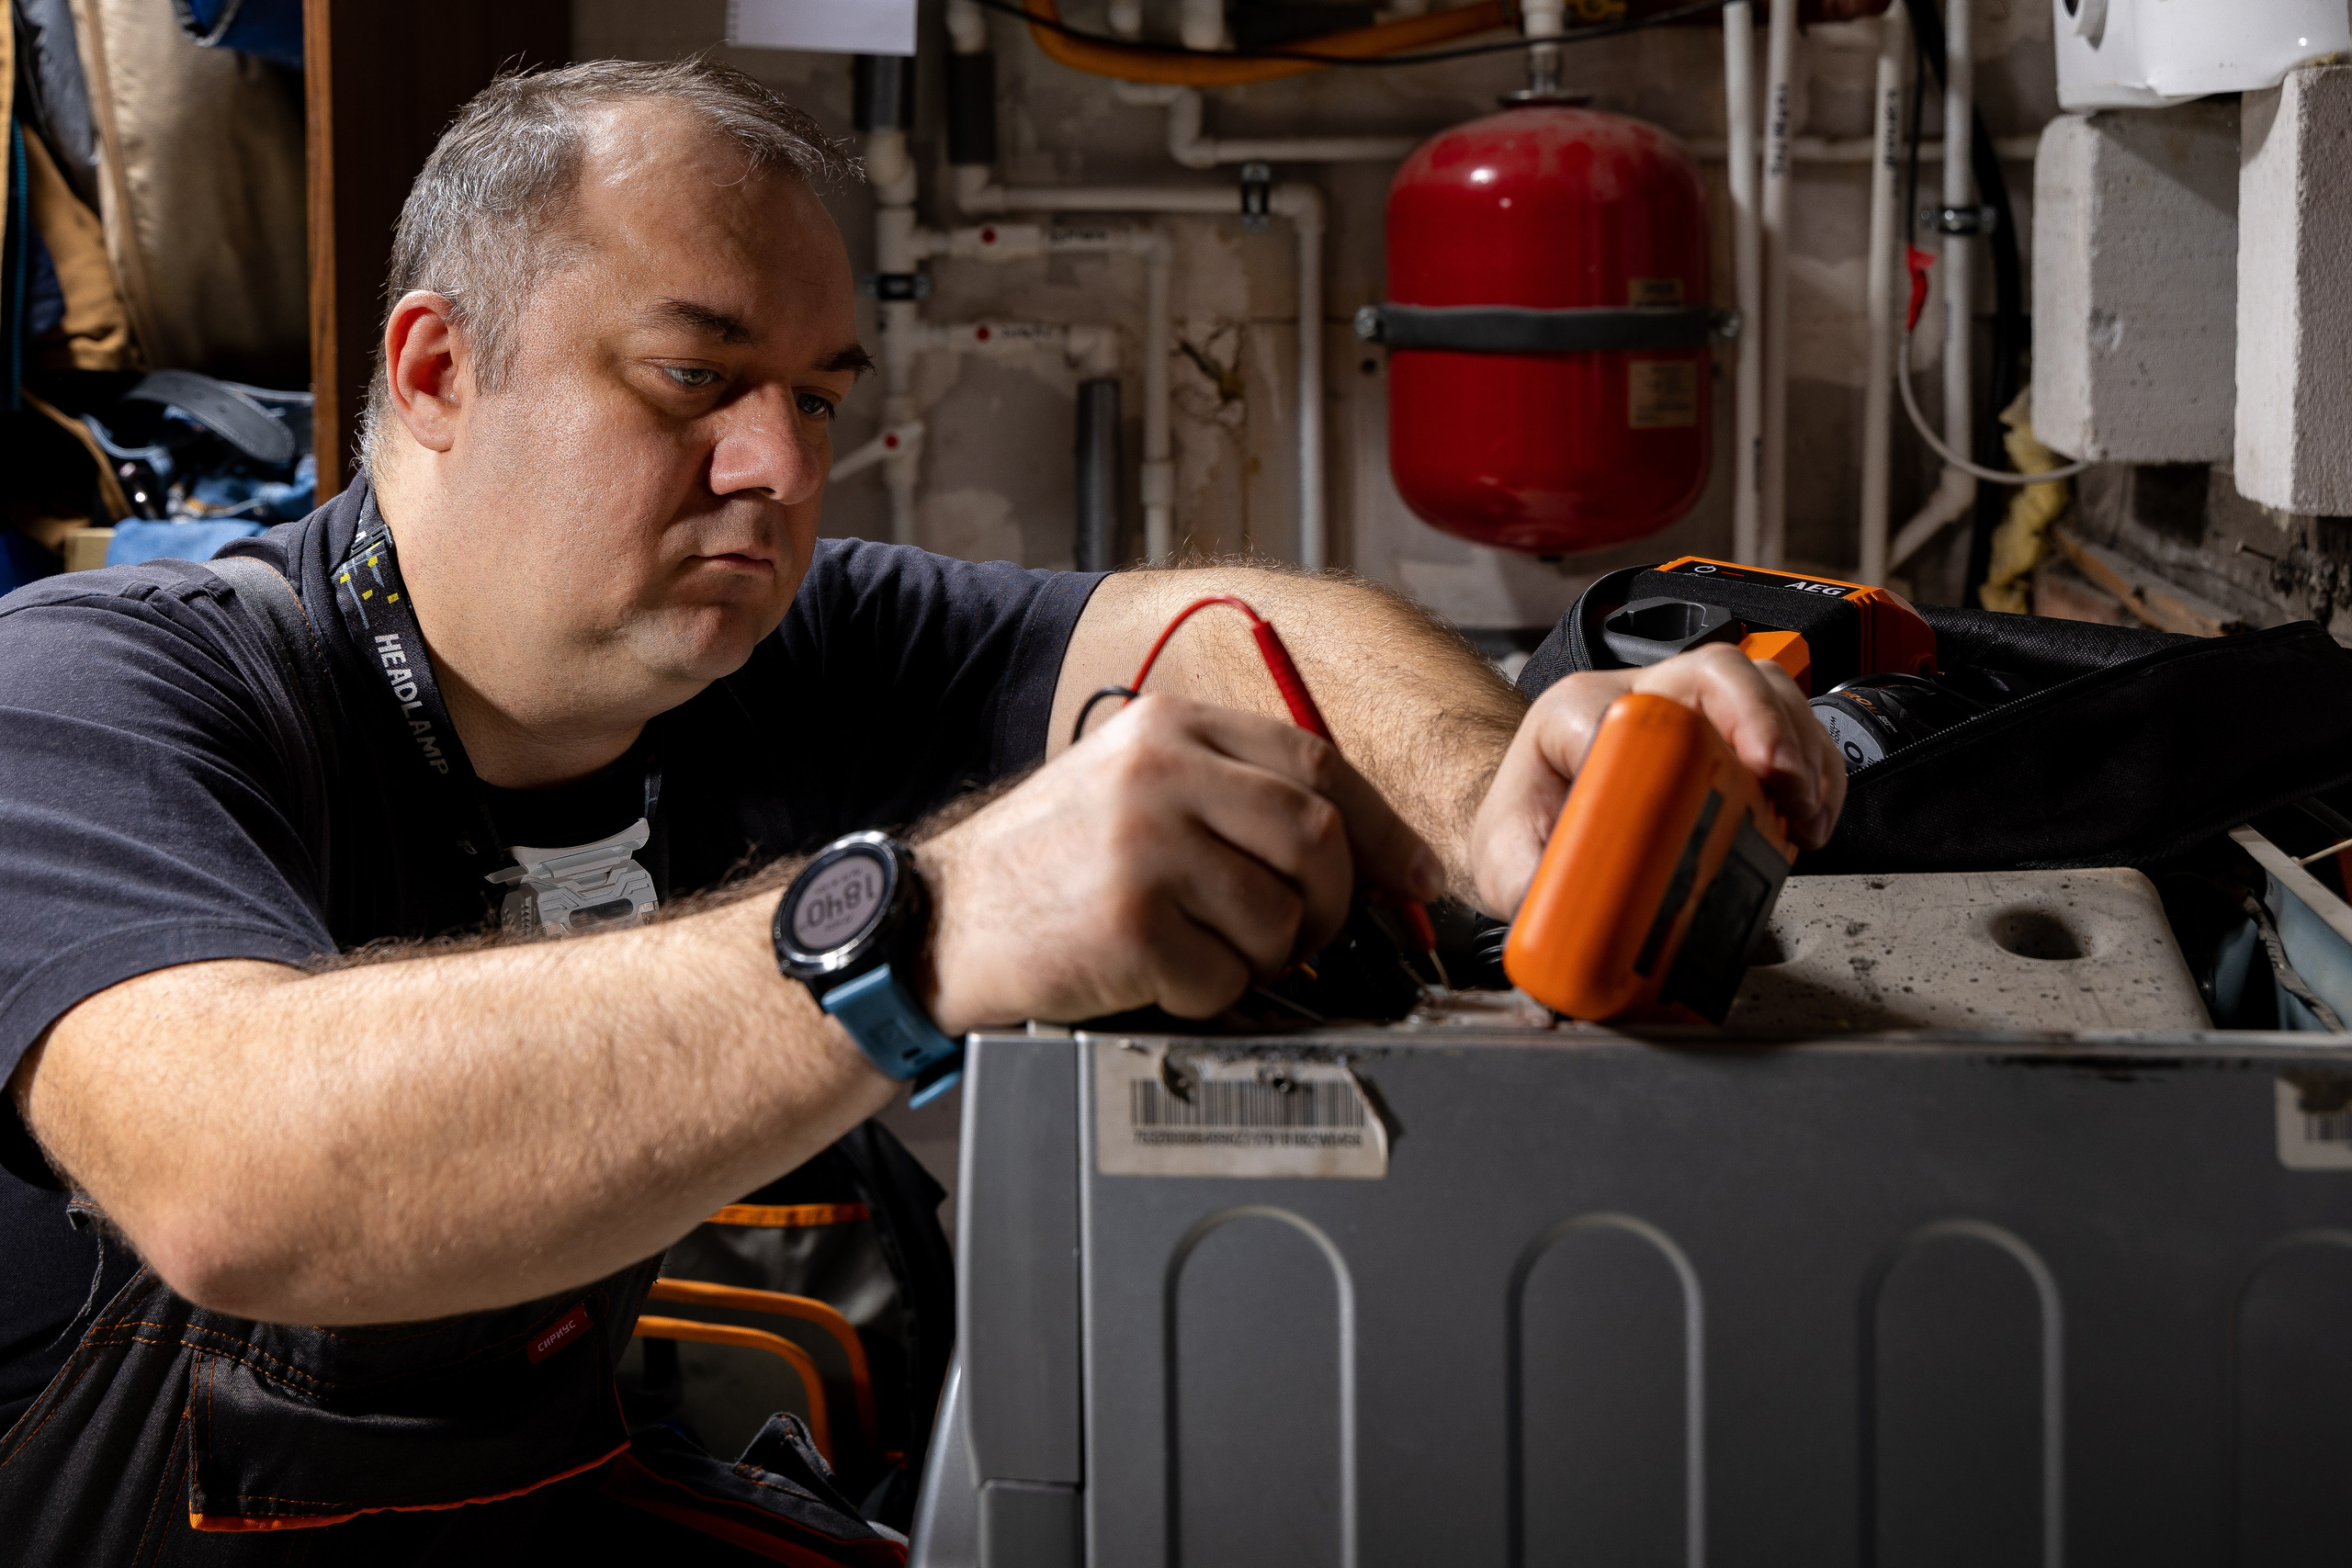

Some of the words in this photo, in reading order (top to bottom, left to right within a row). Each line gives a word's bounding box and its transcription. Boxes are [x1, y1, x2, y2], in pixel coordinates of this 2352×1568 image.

[1785, 581, 1846, 596] AEG
[374, 633, 449, 775] HEADLAMP
[1828, 716, 1837, 738] HIUM
[1834, 728, 1842, 745] ION
[537, 1319, 576, 1352] СИРИУС
